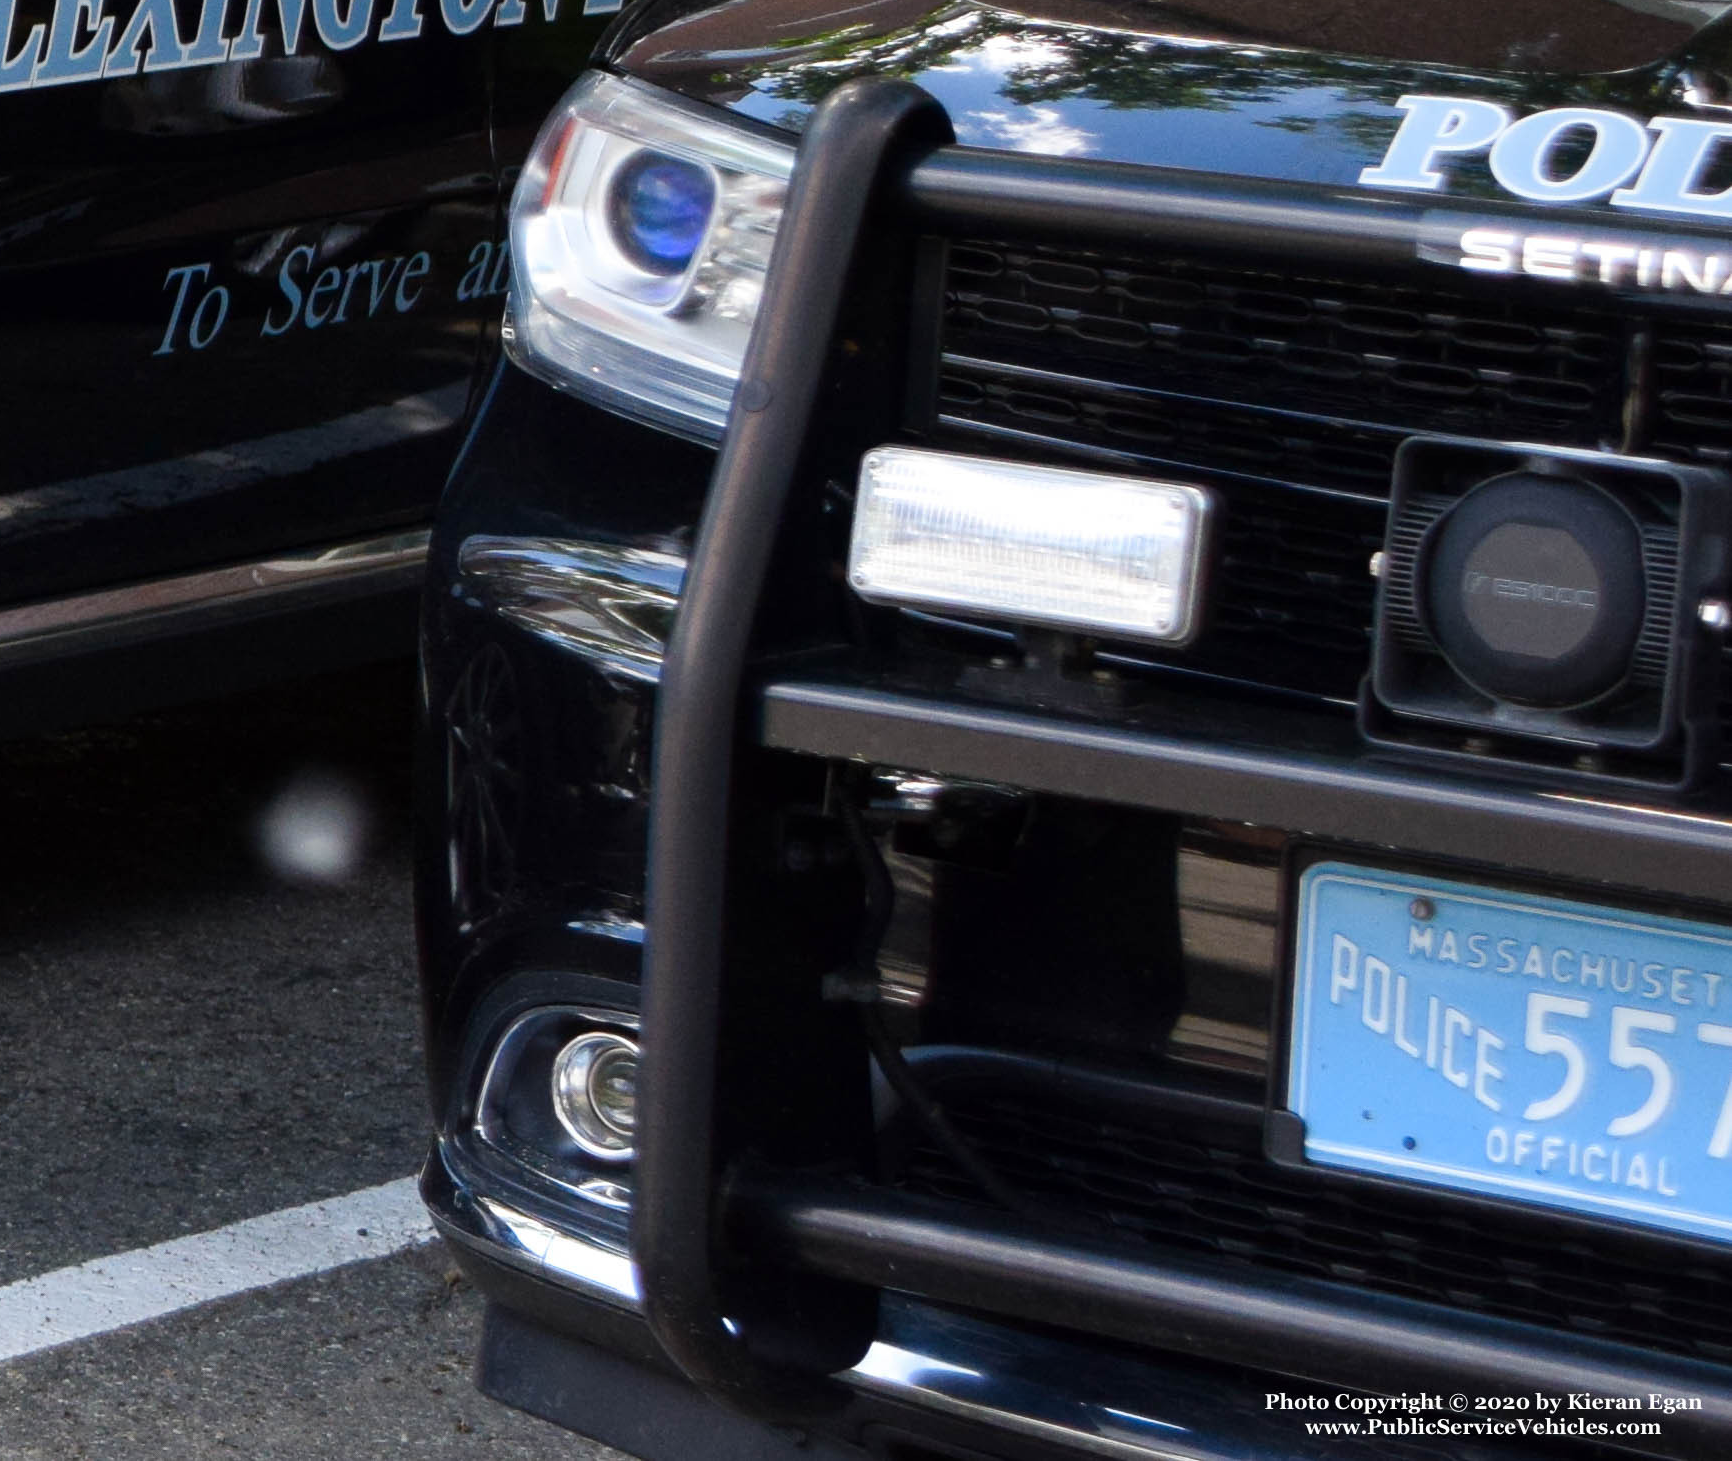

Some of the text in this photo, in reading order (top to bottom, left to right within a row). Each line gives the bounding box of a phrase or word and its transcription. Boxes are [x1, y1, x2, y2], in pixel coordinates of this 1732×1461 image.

[152, 262, 229, 356] To
[259, 243, 431, 337] Serve
[1459, 229, 1732, 295] SETIN
[1408, 923, 1722, 1007] MASSACHUSET
[1329, 933, 1504, 1112] POLICE
[1485, 1126, 1679, 1197] OFFICIAL
